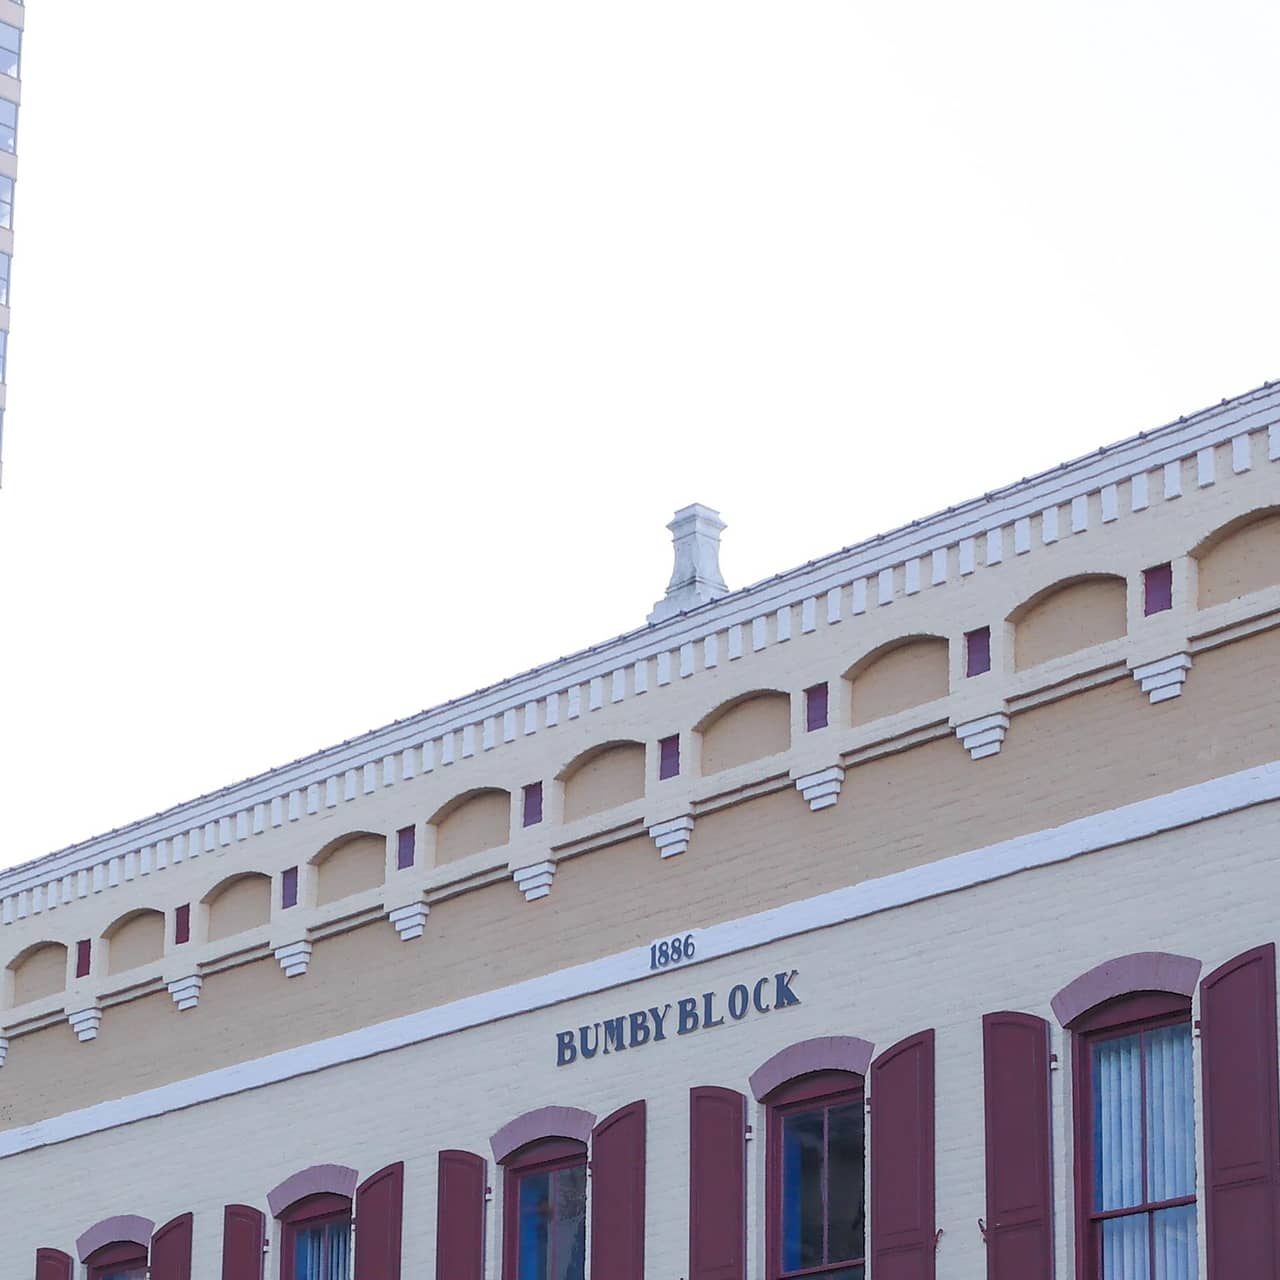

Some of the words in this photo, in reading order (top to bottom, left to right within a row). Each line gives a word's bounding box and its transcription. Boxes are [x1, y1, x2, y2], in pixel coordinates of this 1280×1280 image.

[650, 934, 696, 970] 1886
[556, 1004, 672, 1067] BUMBY
[677, 969, 802, 1036] BLOCK
